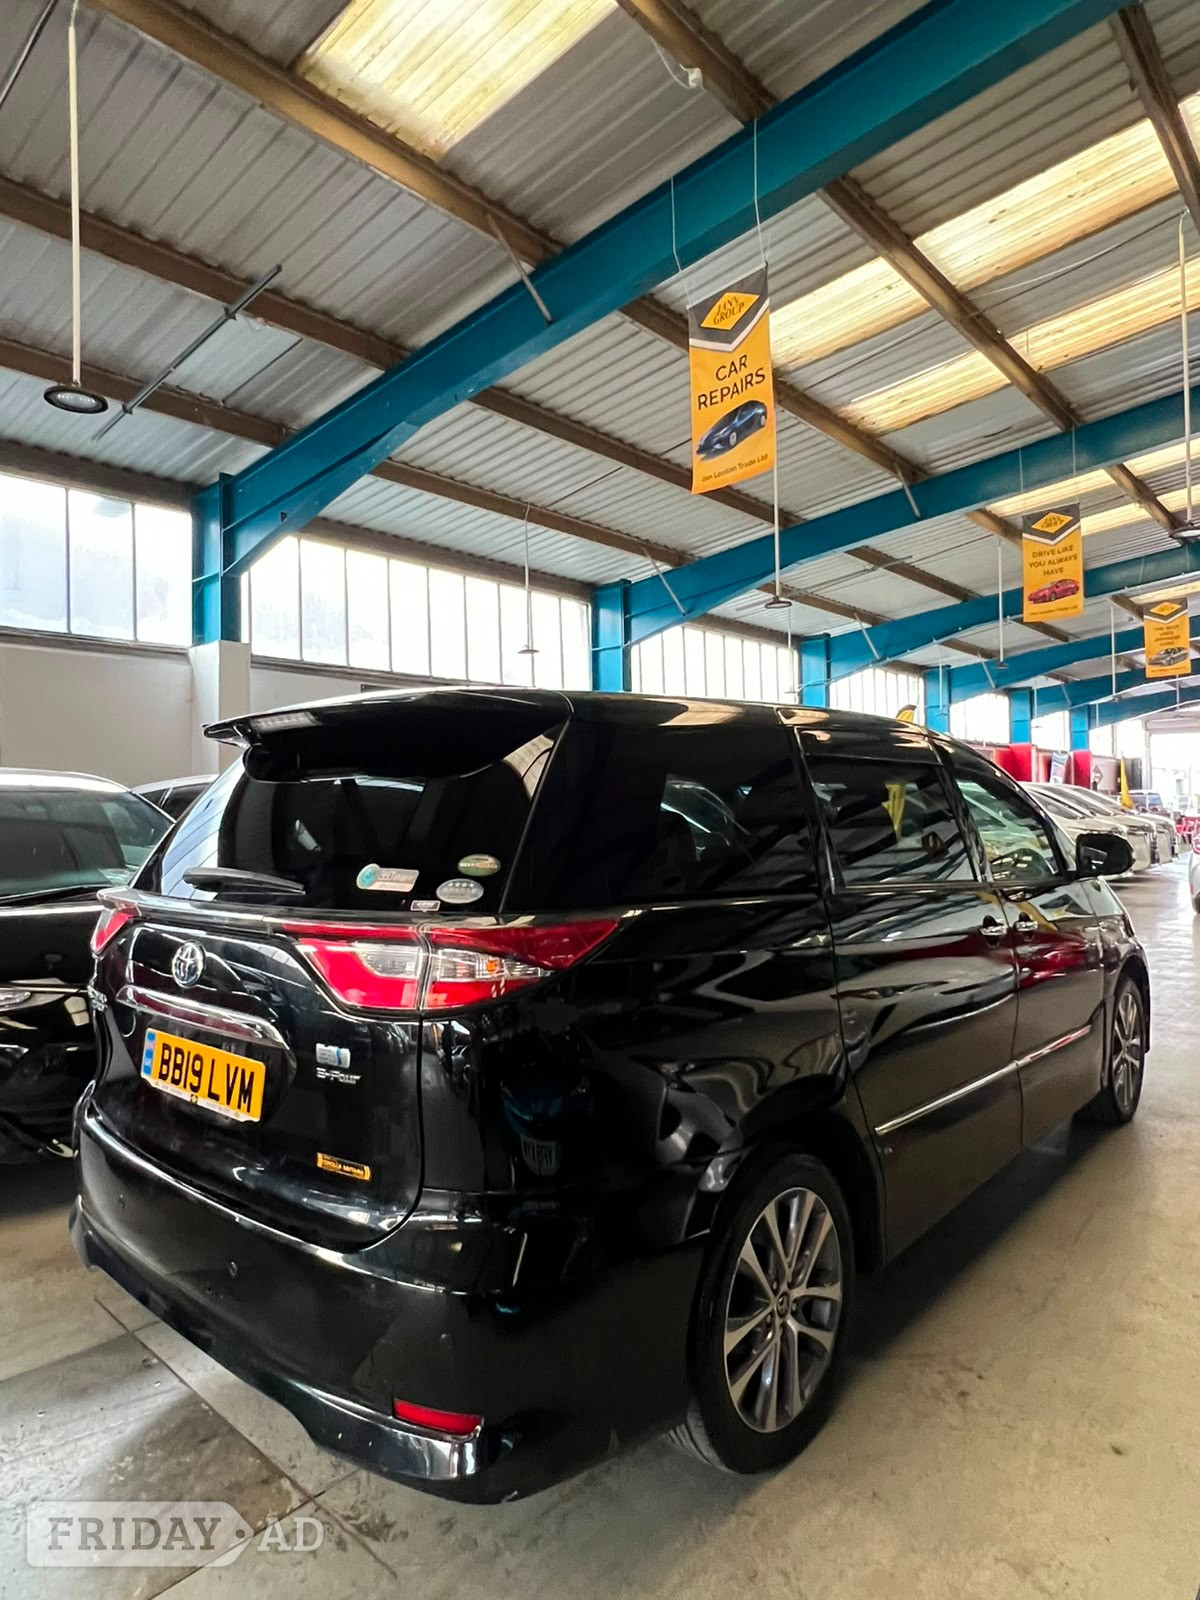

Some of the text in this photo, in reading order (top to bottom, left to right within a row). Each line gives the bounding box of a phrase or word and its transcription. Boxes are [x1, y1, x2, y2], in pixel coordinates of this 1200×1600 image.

[713, 301, 745, 325] GROUP
[715, 354, 748, 382] CAR
[697, 367, 766, 411] REPAIRS
[1029, 554, 1078, 568] YOU ALWAYS
[1032, 544, 1074, 559] DRIVE LIKE
[1043, 567, 1064, 576] HAVE
[158, 1042, 255, 1113] BB19 LVM
